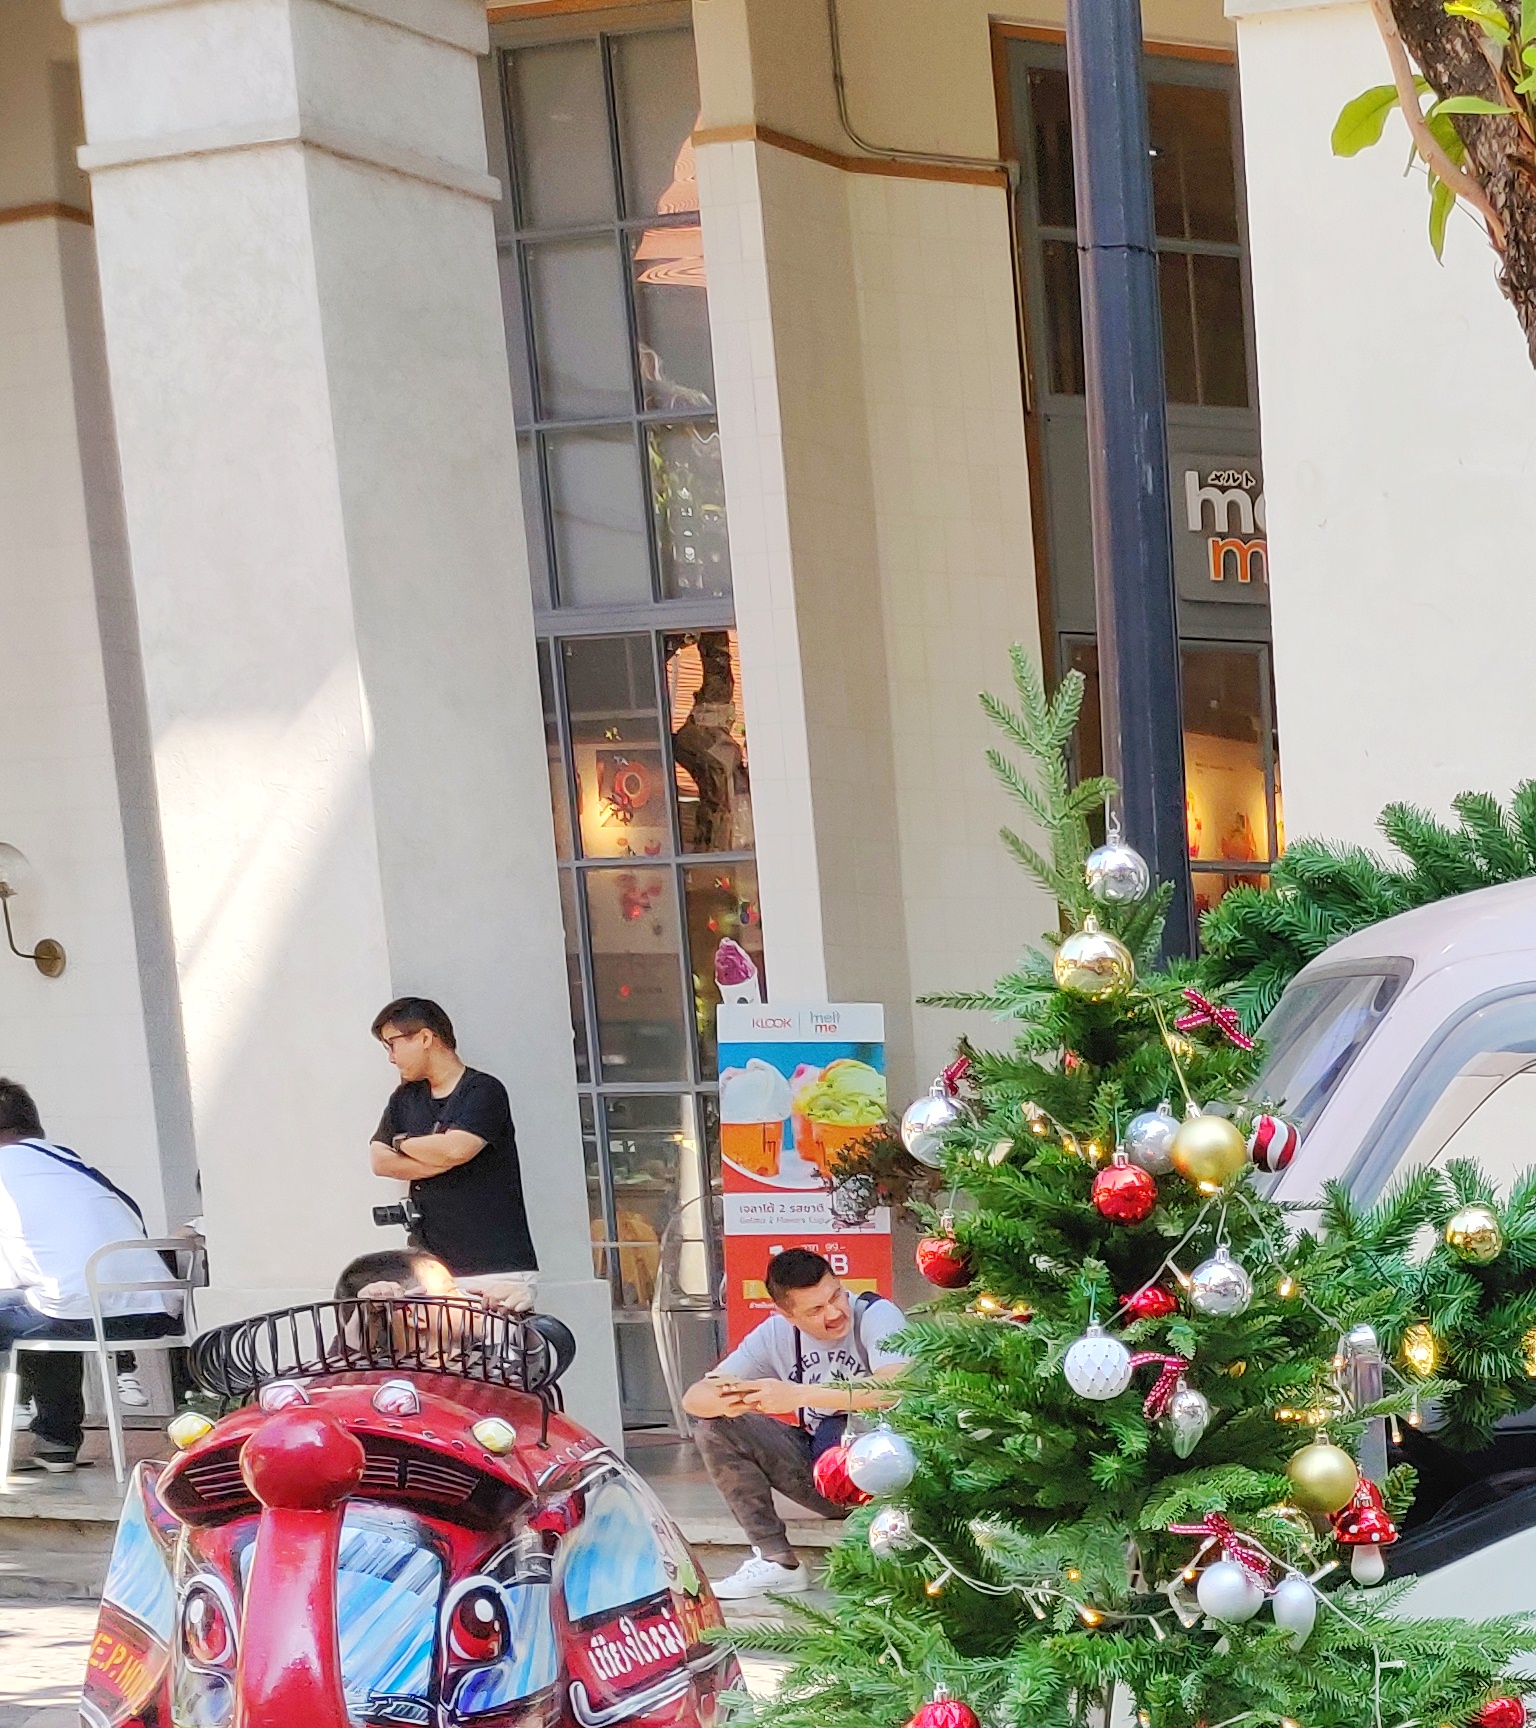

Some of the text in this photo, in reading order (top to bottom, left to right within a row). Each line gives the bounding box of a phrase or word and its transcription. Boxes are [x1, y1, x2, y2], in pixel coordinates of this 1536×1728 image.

[1208, 470, 1256, 489] メルト
[809, 1010, 840, 1024] melt
[752, 1018, 792, 1029] KLOOK
[815, 1024, 838, 1033] me
[779, 1203, 786, 1213] 2
